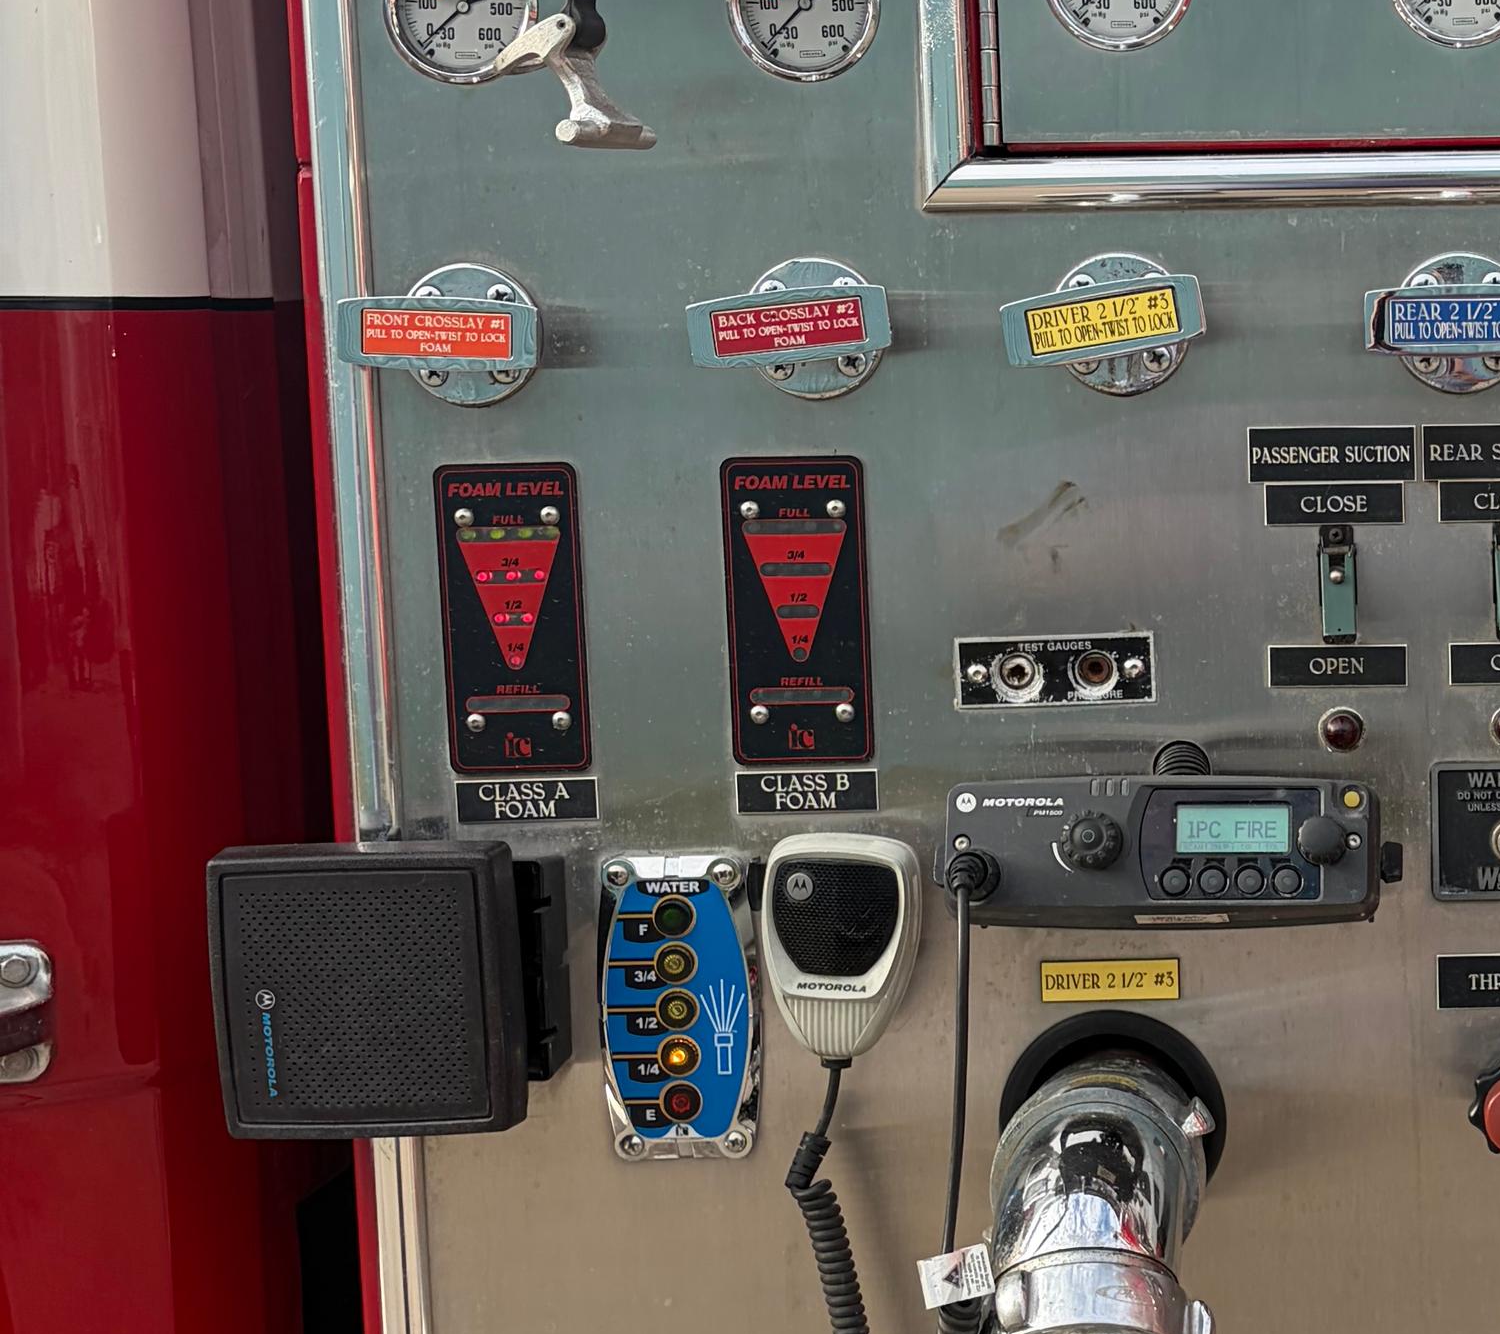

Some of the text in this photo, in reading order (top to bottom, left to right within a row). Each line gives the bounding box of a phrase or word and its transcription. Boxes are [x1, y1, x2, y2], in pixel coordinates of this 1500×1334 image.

[1394, 303, 1444, 320] REAR
[1449, 303, 1460, 320] 2
[366, 313, 506, 331] FRONT CROSSLAY #1
[1394, 321, 1415, 338] PULL
[1418, 322, 1431, 338] TO
[419, 341, 452, 354] FOAM
[1252, 444, 1411, 464] PASSENGER SUCTION
[1430, 444, 1483, 462] REAR
[448, 481, 564, 497] FOAM LEVEL
[1300, 495, 1368, 513] CLOSE
[492, 515, 523, 524] FULL
[786, 550, 805, 560] 3/4
[789, 592, 807, 603] 1/2
[792, 635, 808, 645] 1/4
[1018, 641, 1092, 652] TEST GAUGES
[780, 677, 823, 687] REFILL
[479, 782, 570, 801] CLASS A
[982, 797, 1063, 808] MOTOROLA
[494, 801, 557, 819] FOAM
[1234, 821, 1278, 838] FIRE
[646, 881, 700, 893] WATER
[639, 924, 648, 936] F
[634, 971, 657, 983] 3/4
[1045, 972, 1100, 990] DRIVER
[1107, 973, 1116, 988] 2
[1154, 971, 1175, 988] #3
[797, 982, 867, 993] MOTOROLA
[262, 1012, 277, 1098] MOTOROLA
[646, 1110, 656, 1121] E
